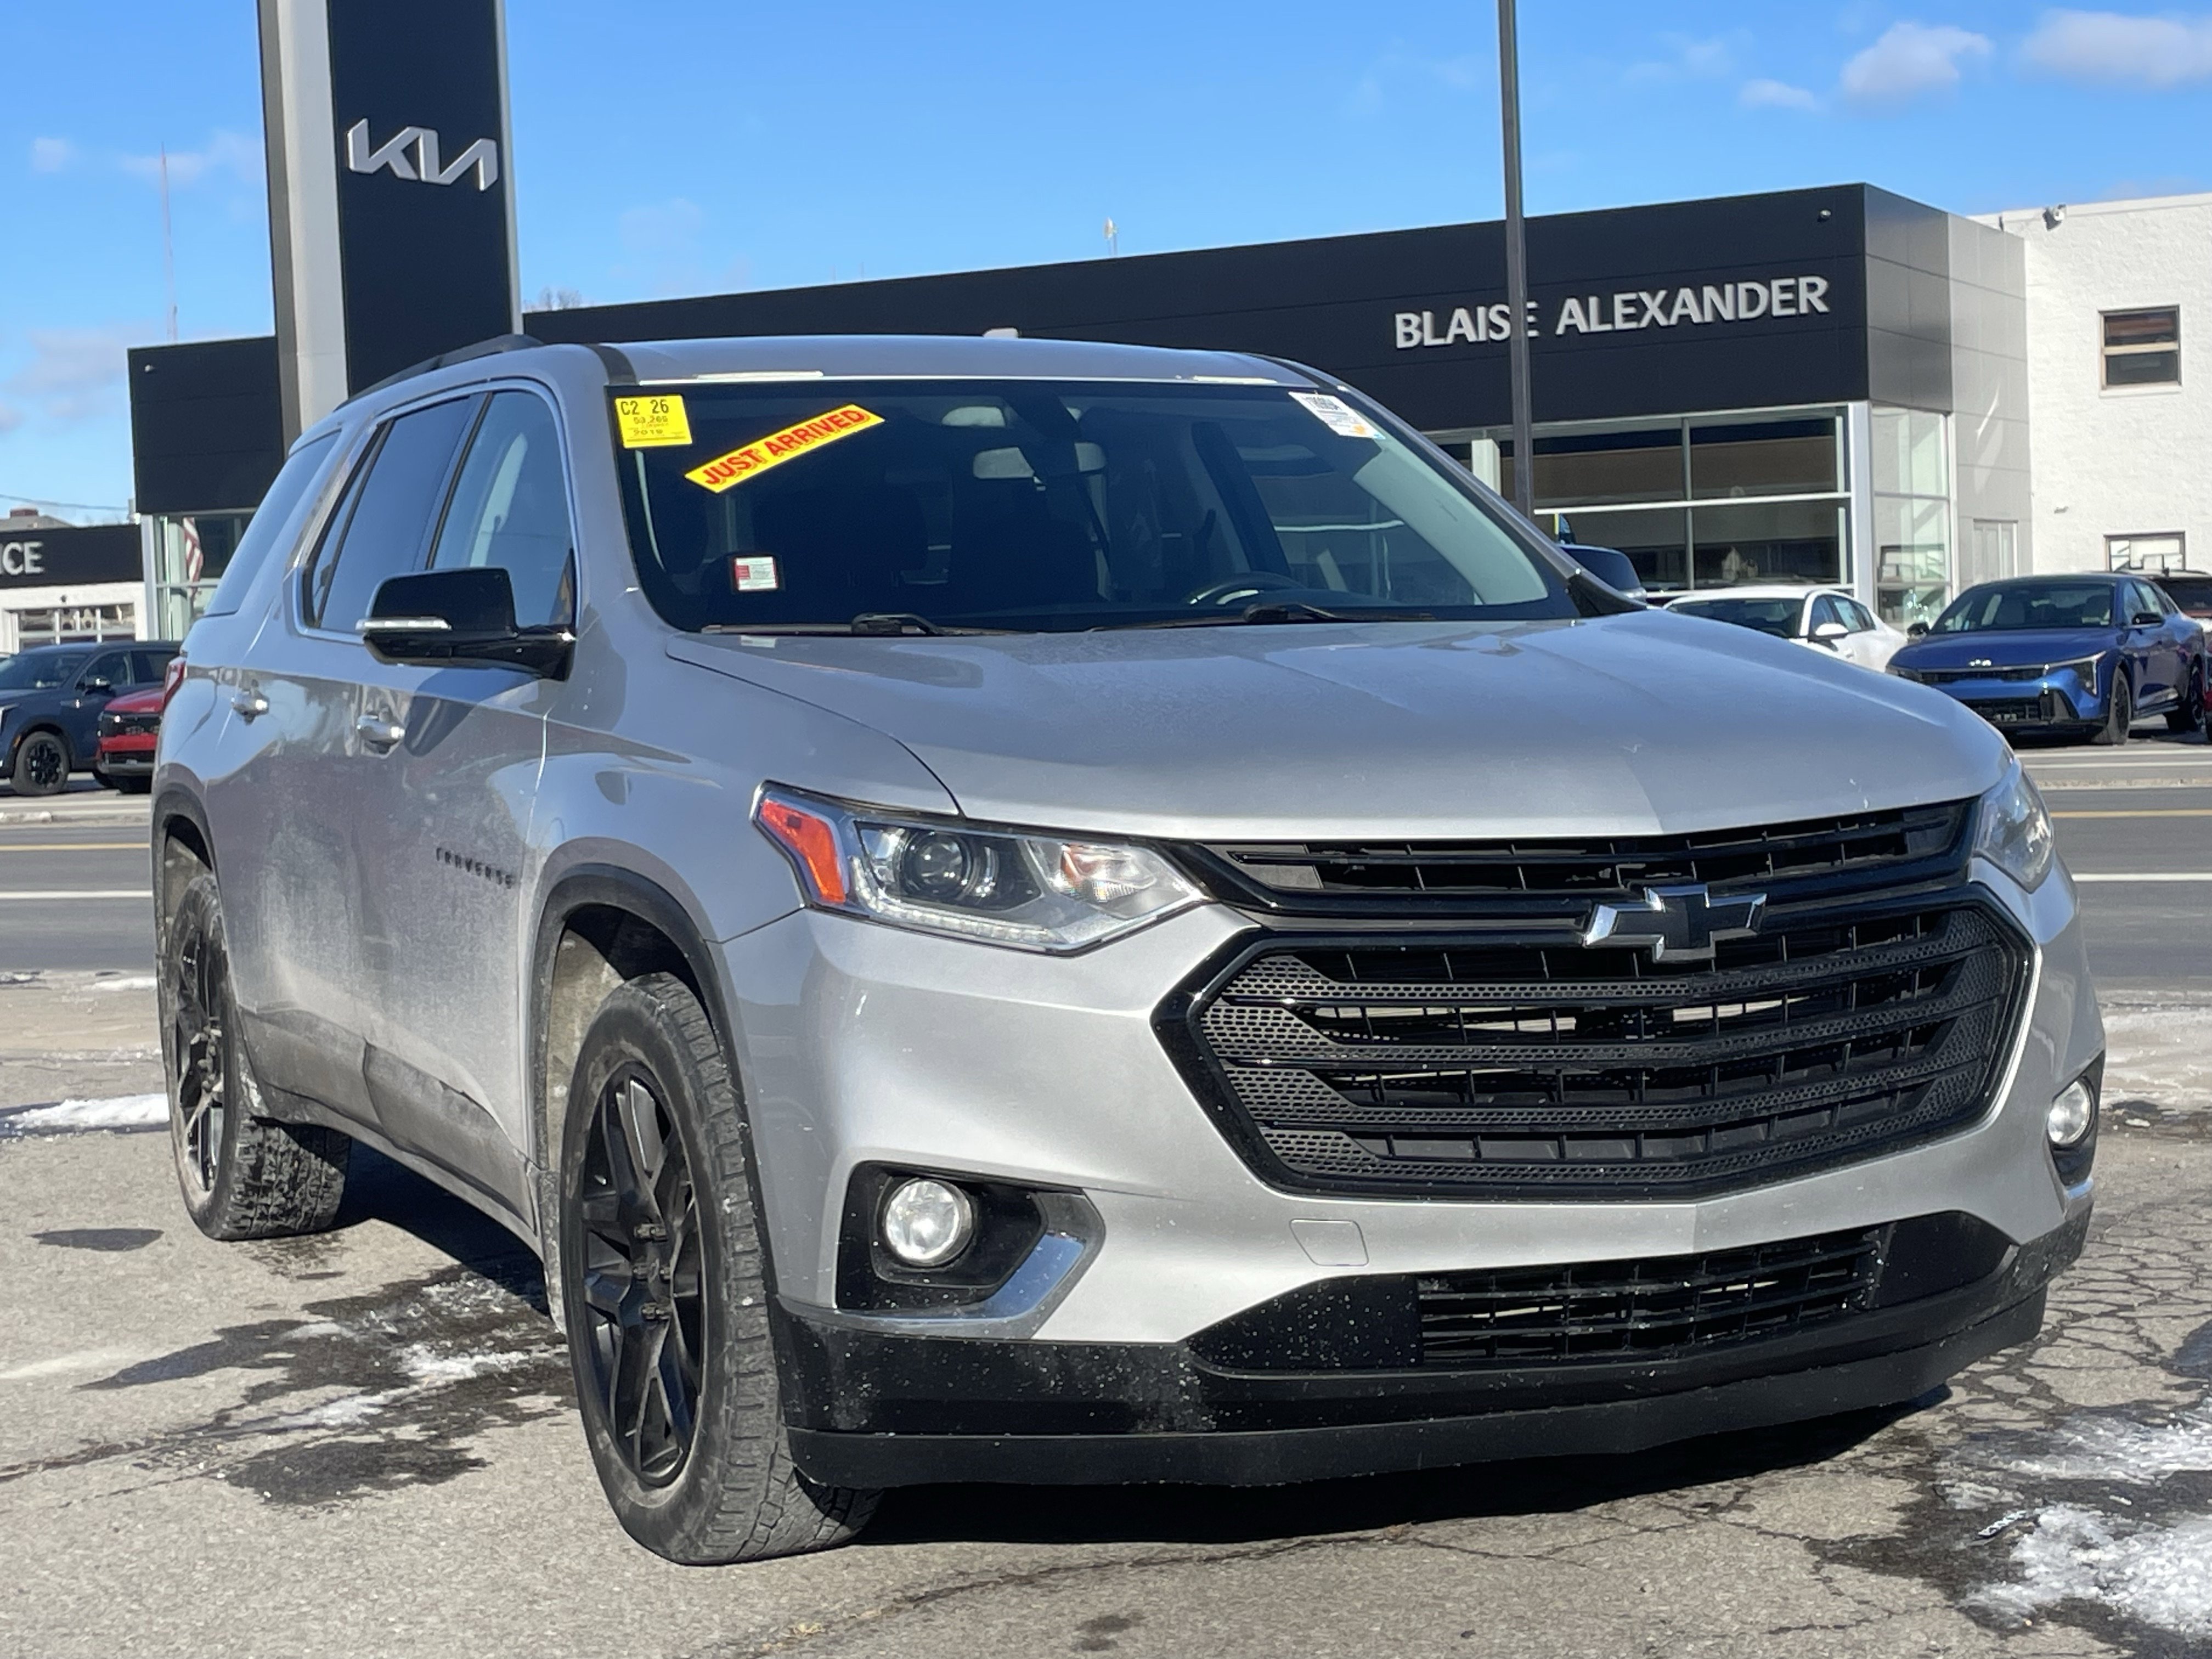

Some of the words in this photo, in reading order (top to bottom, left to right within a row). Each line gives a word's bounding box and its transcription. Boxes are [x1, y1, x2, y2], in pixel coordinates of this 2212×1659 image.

[1555, 275, 1830, 336] ALEXANDER
[620, 400, 640, 415] C2
[650, 399, 669, 414] 26
[703, 448, 766, 485] JUST
[764, 409, 871, 458] ARRIVED
